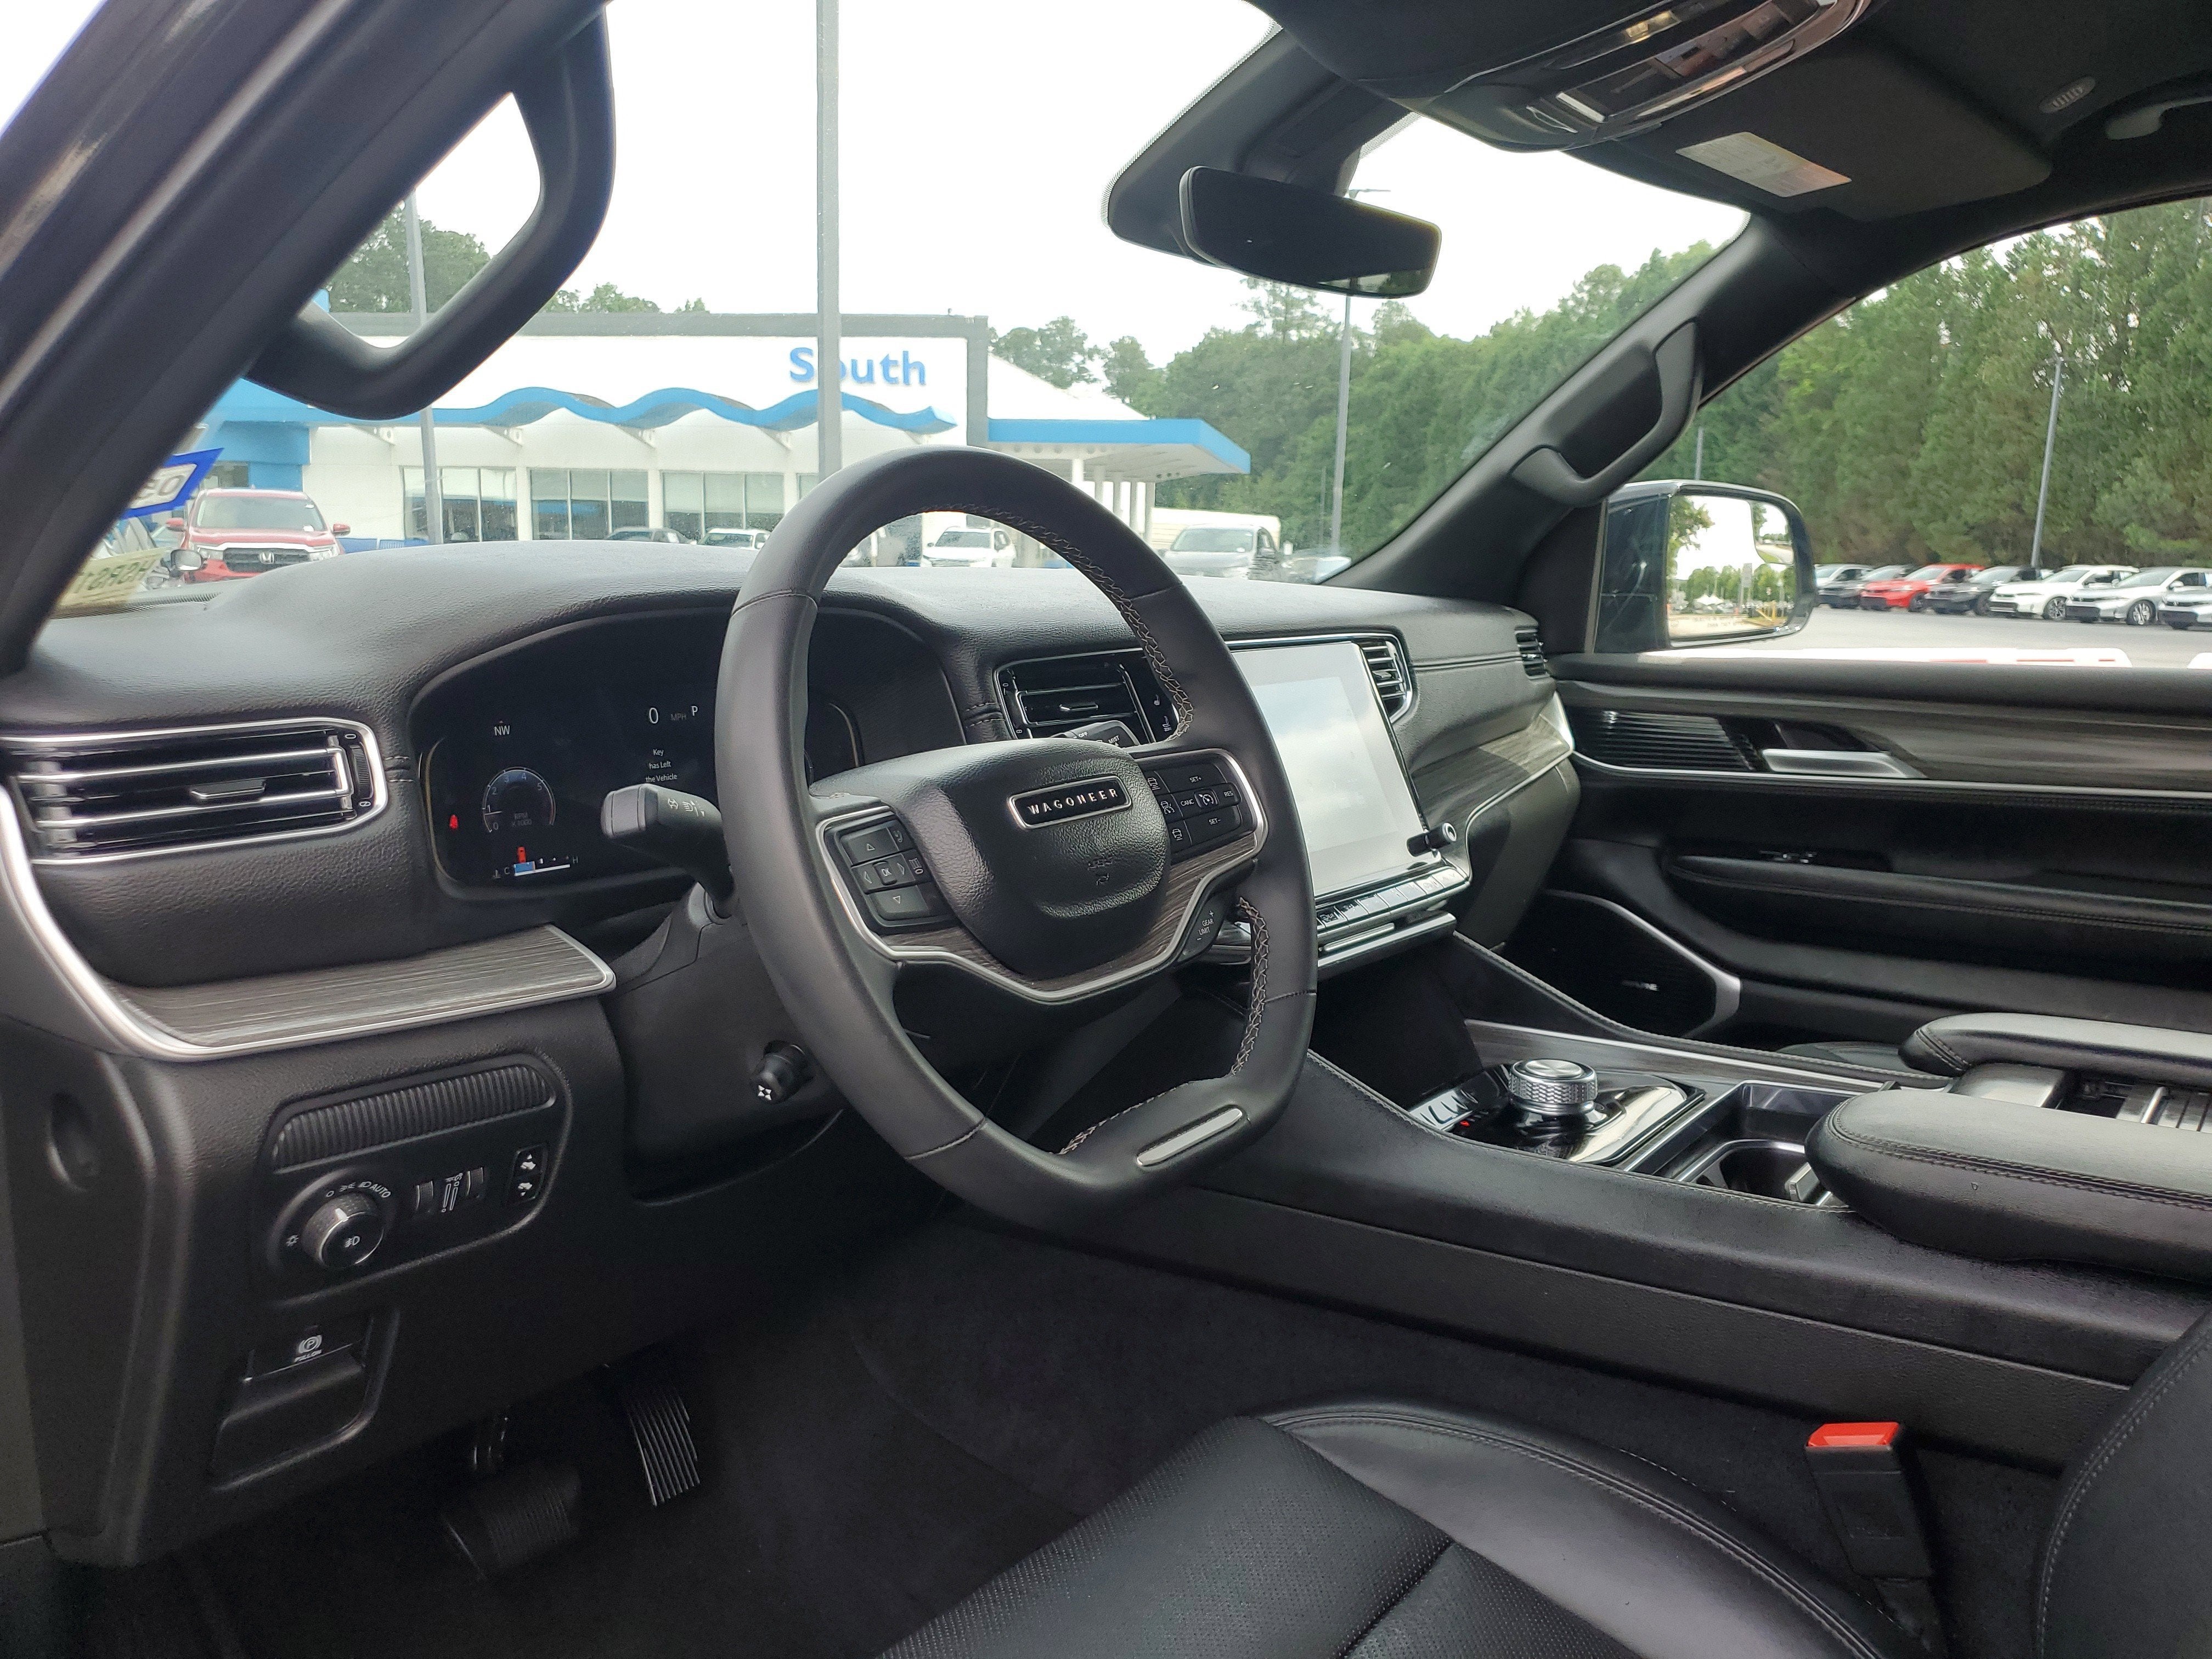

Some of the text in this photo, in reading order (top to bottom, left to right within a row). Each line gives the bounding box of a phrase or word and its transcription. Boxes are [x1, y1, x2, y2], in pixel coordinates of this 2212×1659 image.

[789, 347, 926, 386] Suth
[648, 706, 698, 724] 0 MPH P
[494, 725, 510, 736] NW
[1108, 735, 1120, 744] MIST
[656, 773, 678, 782] Vehicle
[1028, 788, 1119, 815] WAGONEER
[573, 856, 578, 864] H
[881, 867, 892, 877] OK
[1202, 918, 1214, 927] GEAR
[1198, 926, 1210, 935] LIMIT
[369, 1183, 391, 1198] AUTO
